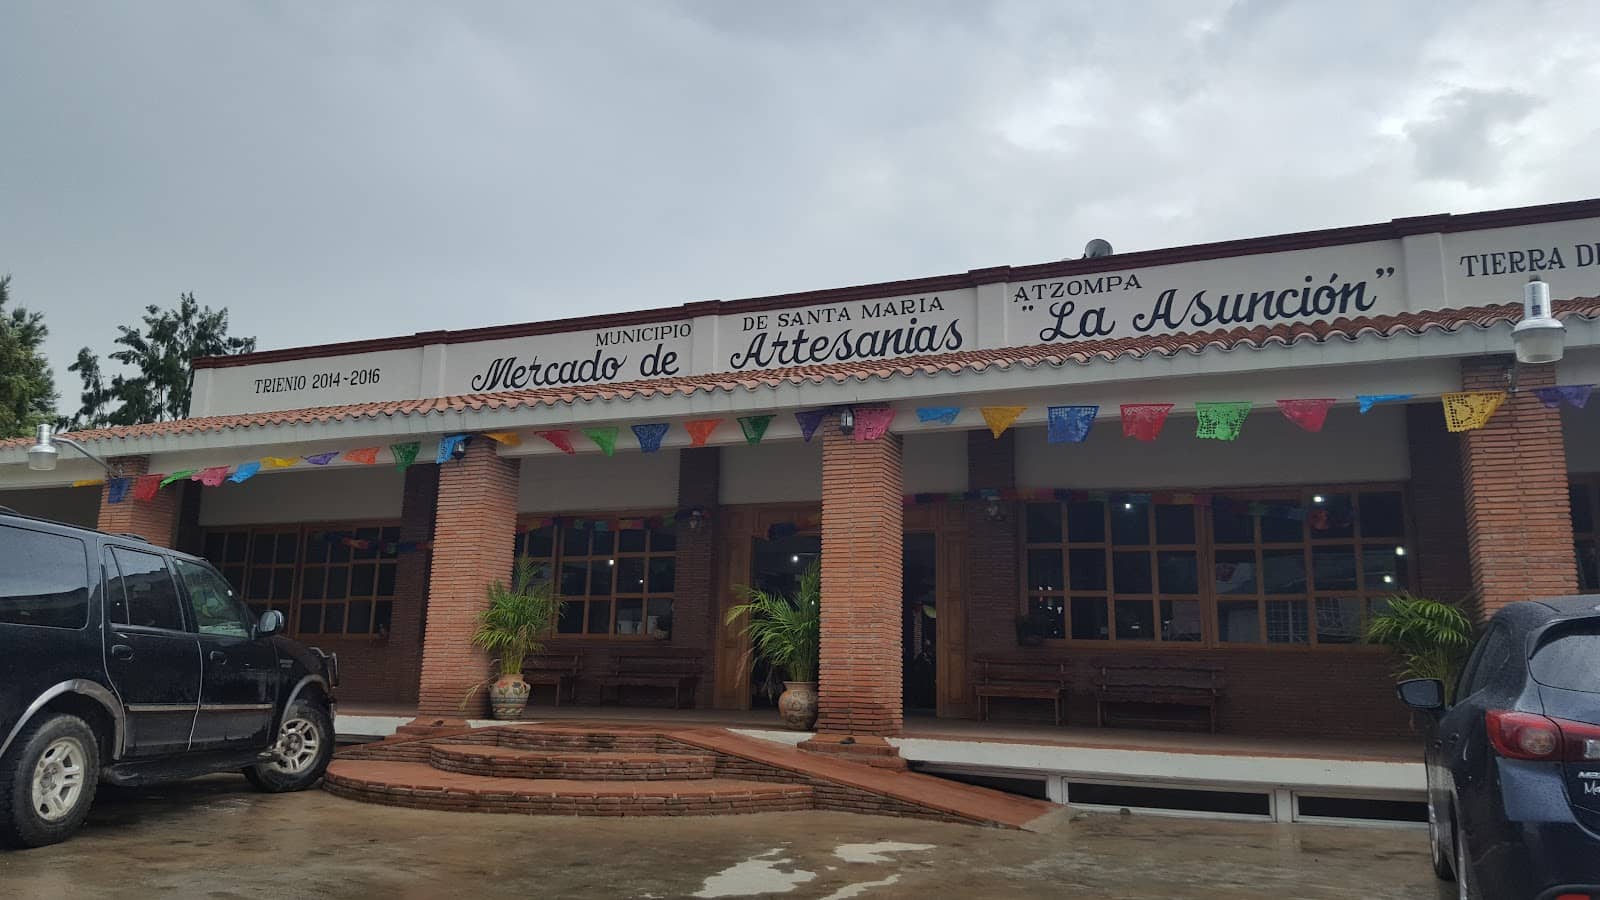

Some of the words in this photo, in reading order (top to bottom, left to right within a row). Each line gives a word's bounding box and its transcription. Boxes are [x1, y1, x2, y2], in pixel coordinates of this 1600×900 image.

[1460, 247, 1565, 277] TIERRA
[595, 323, 692, 346] MUNICIPIO
[743, 315, 768, 331] DE
[777, 308, 851, 328] SANTA
[861, 296, 944, 319] MARIA
[1014, 274, 1142, 302] ATZOMPA
[471, 349, 627, 391] Mercado
[639, 344, 680, 376] de
[730, 318, 963, 369] Artesanias
[254, 376, 306, 394] TRIENIO
[312, 368, 380, 389] 2014-2016
